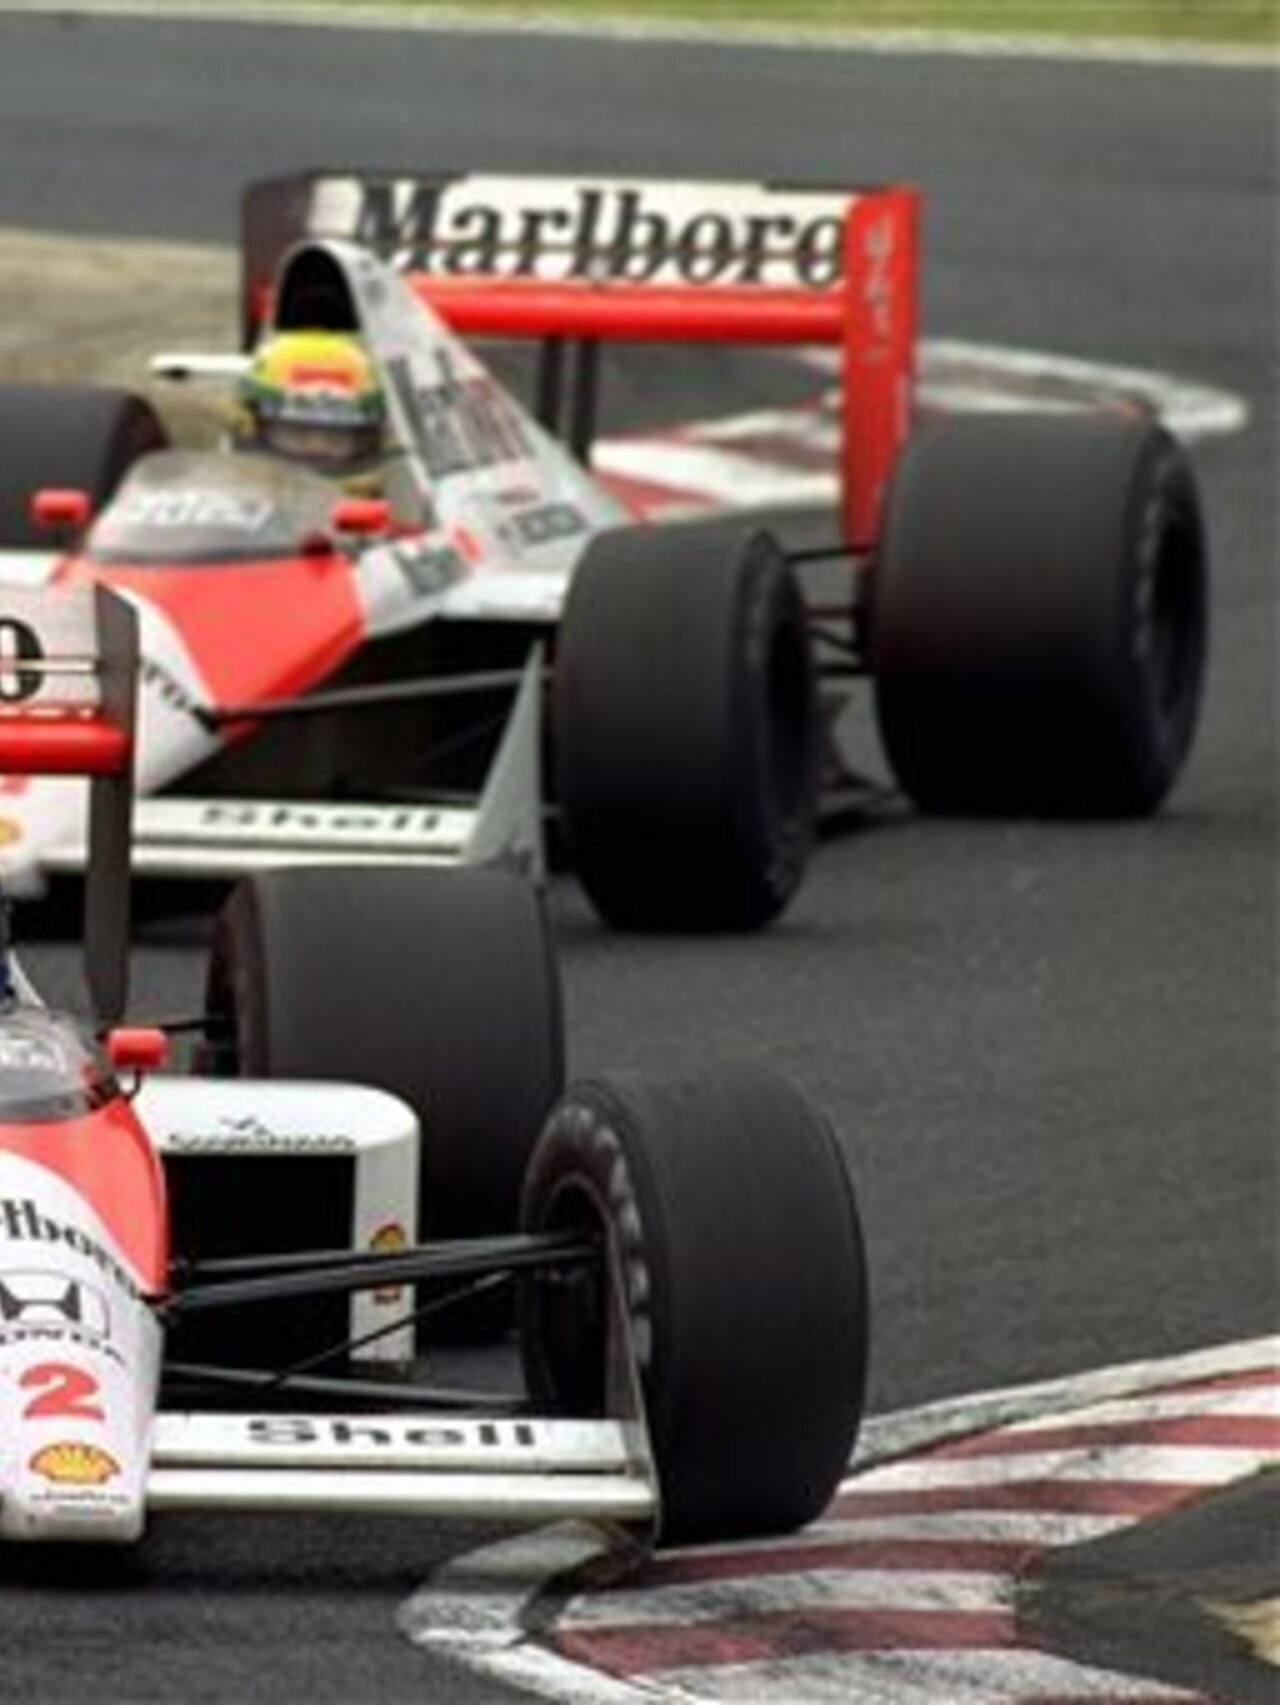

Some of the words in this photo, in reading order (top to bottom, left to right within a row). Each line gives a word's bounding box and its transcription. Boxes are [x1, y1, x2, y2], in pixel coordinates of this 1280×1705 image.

[357, 180, 846, 287] Marlboro
[199, 806, 442, 832] Shell
[19, 1360, 106, 1421] 2
[246, 1419, 537, 1447] Shell
